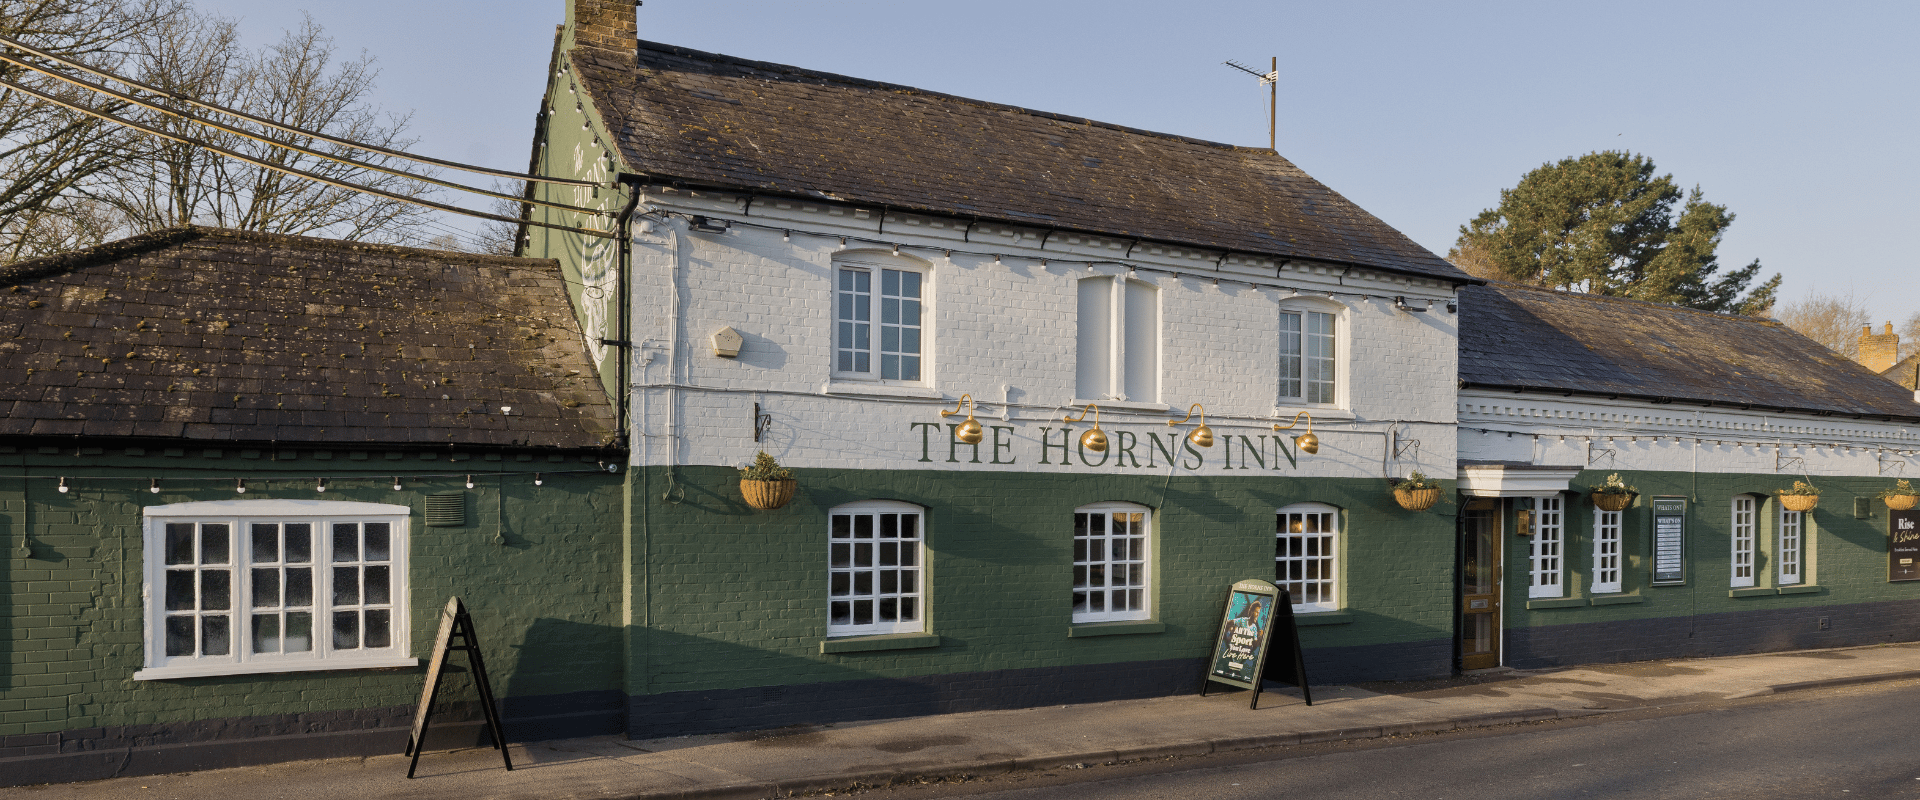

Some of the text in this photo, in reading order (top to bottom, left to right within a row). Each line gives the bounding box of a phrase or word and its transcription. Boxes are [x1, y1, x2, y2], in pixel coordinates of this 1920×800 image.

[574, 156, 606, 218] HORNS
[910, 422, 1300, 471] THE HORNS INN
[1898, 518, 1914, 529] Rise
[1893, 530, 1920, 543] & Shine
[1231, 634, 1253, 645] Sport
[1223, 648, 1237, 658] Live
